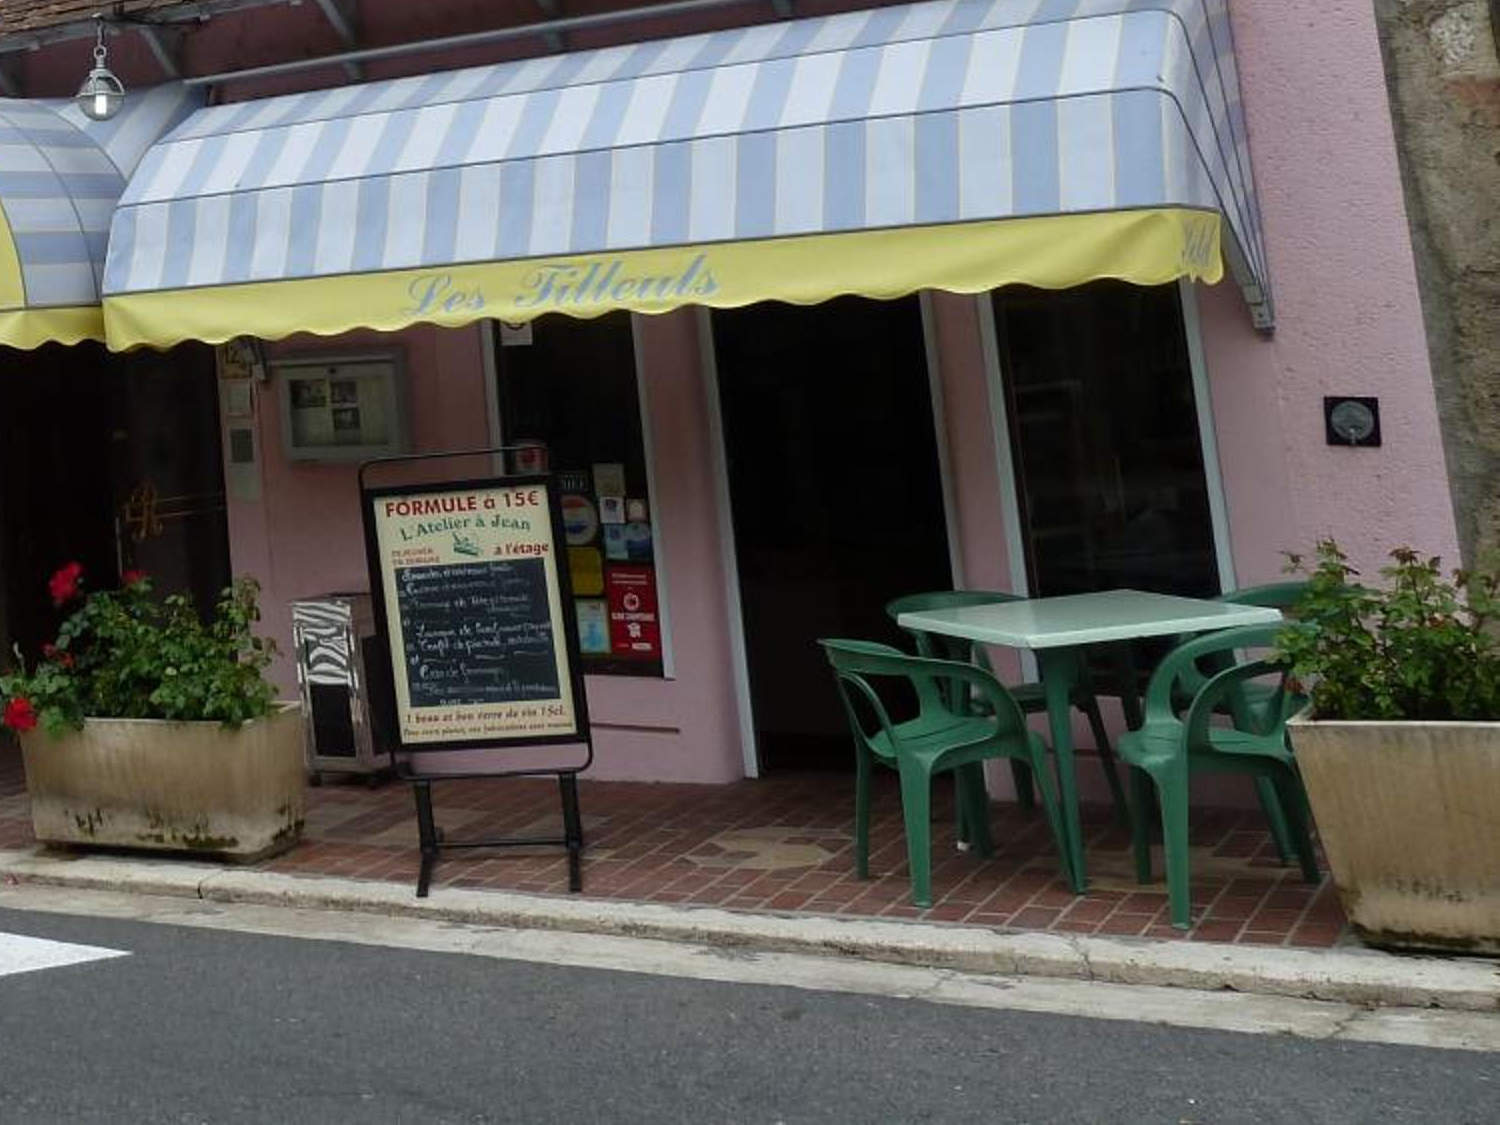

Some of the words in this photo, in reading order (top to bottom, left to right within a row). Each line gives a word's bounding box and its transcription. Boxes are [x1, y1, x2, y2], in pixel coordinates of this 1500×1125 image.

[403, 275, 486, 316] Les
[514, 251, 721, 310] Tilleuls
[385, 496, 477, 518] FORMULE
[503, 490, 540, 508] 15€
[400, 516, 470, 542] L'Atelier
[491, 514, 532, 532] Jean
[504, 542, 549, 557] l'étage
